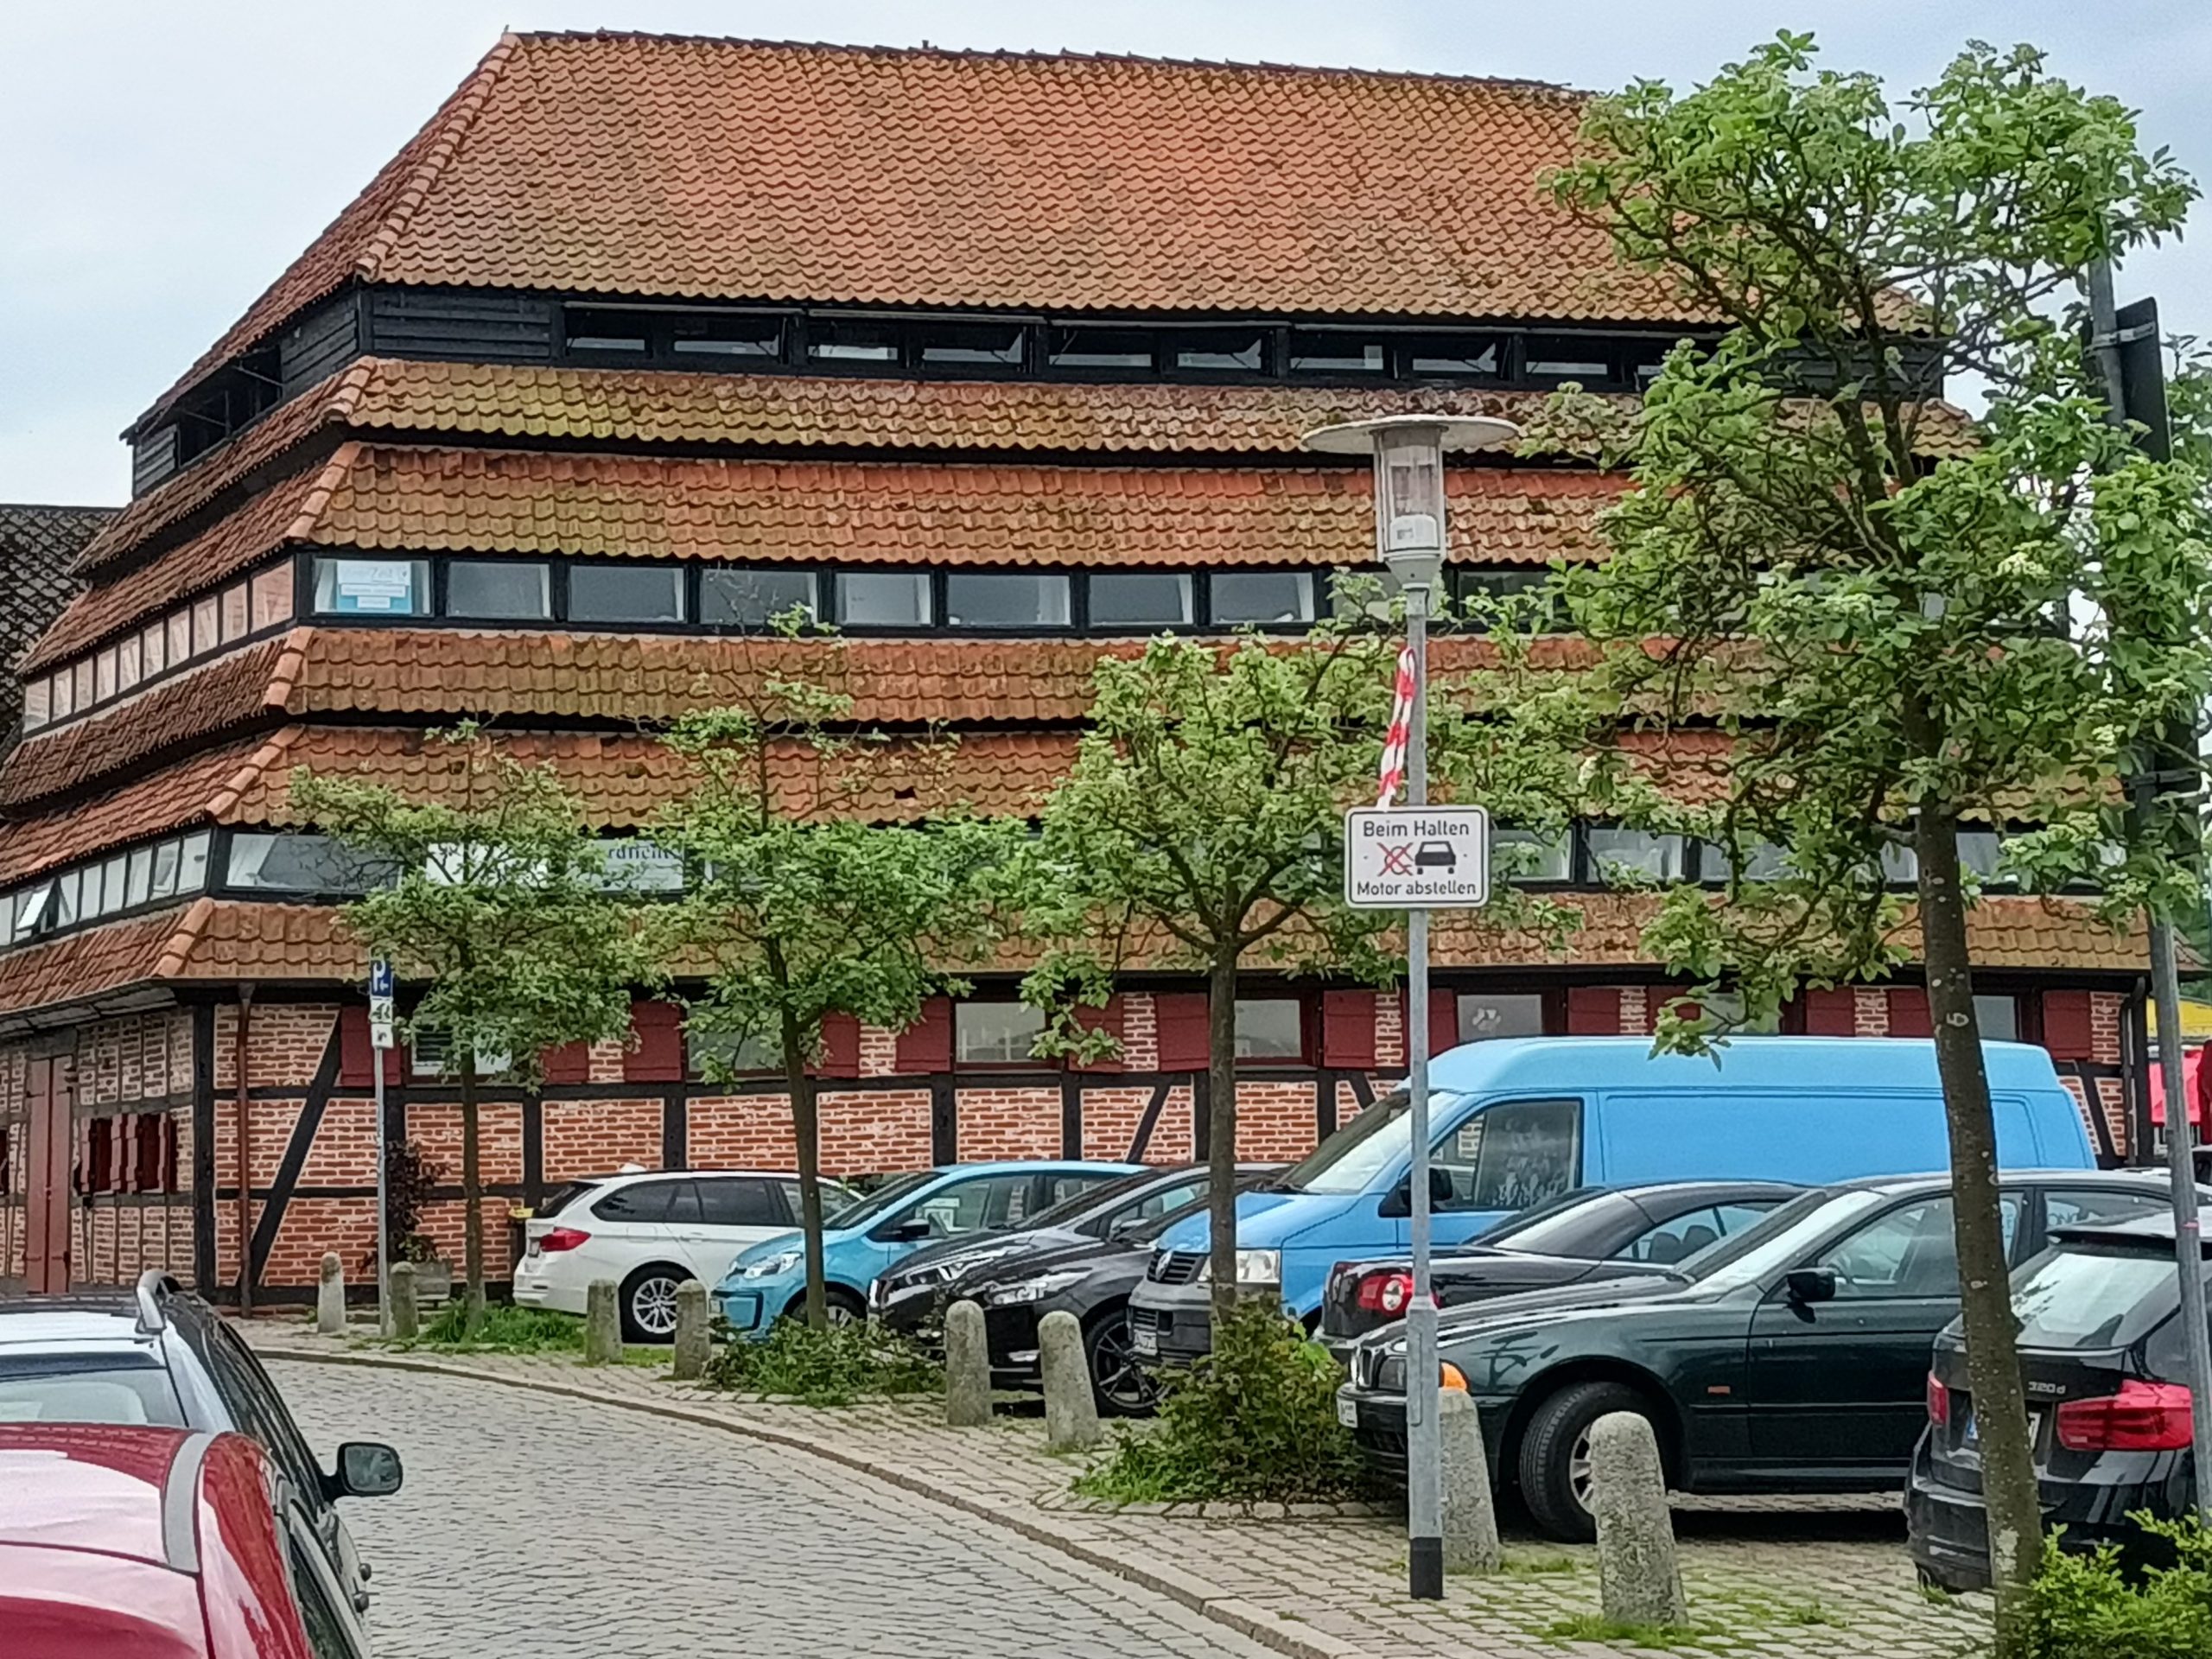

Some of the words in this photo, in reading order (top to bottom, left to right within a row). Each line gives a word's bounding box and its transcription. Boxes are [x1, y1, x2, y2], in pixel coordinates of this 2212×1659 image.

[1363, 821, 1408, 836] Beim
[1415, 820, 1469, 836] Halten
[1357, 881, 1402, 896] Motor
[1407, 880, 1476, 895] abstellen
[372, 959, 386, 993] P
